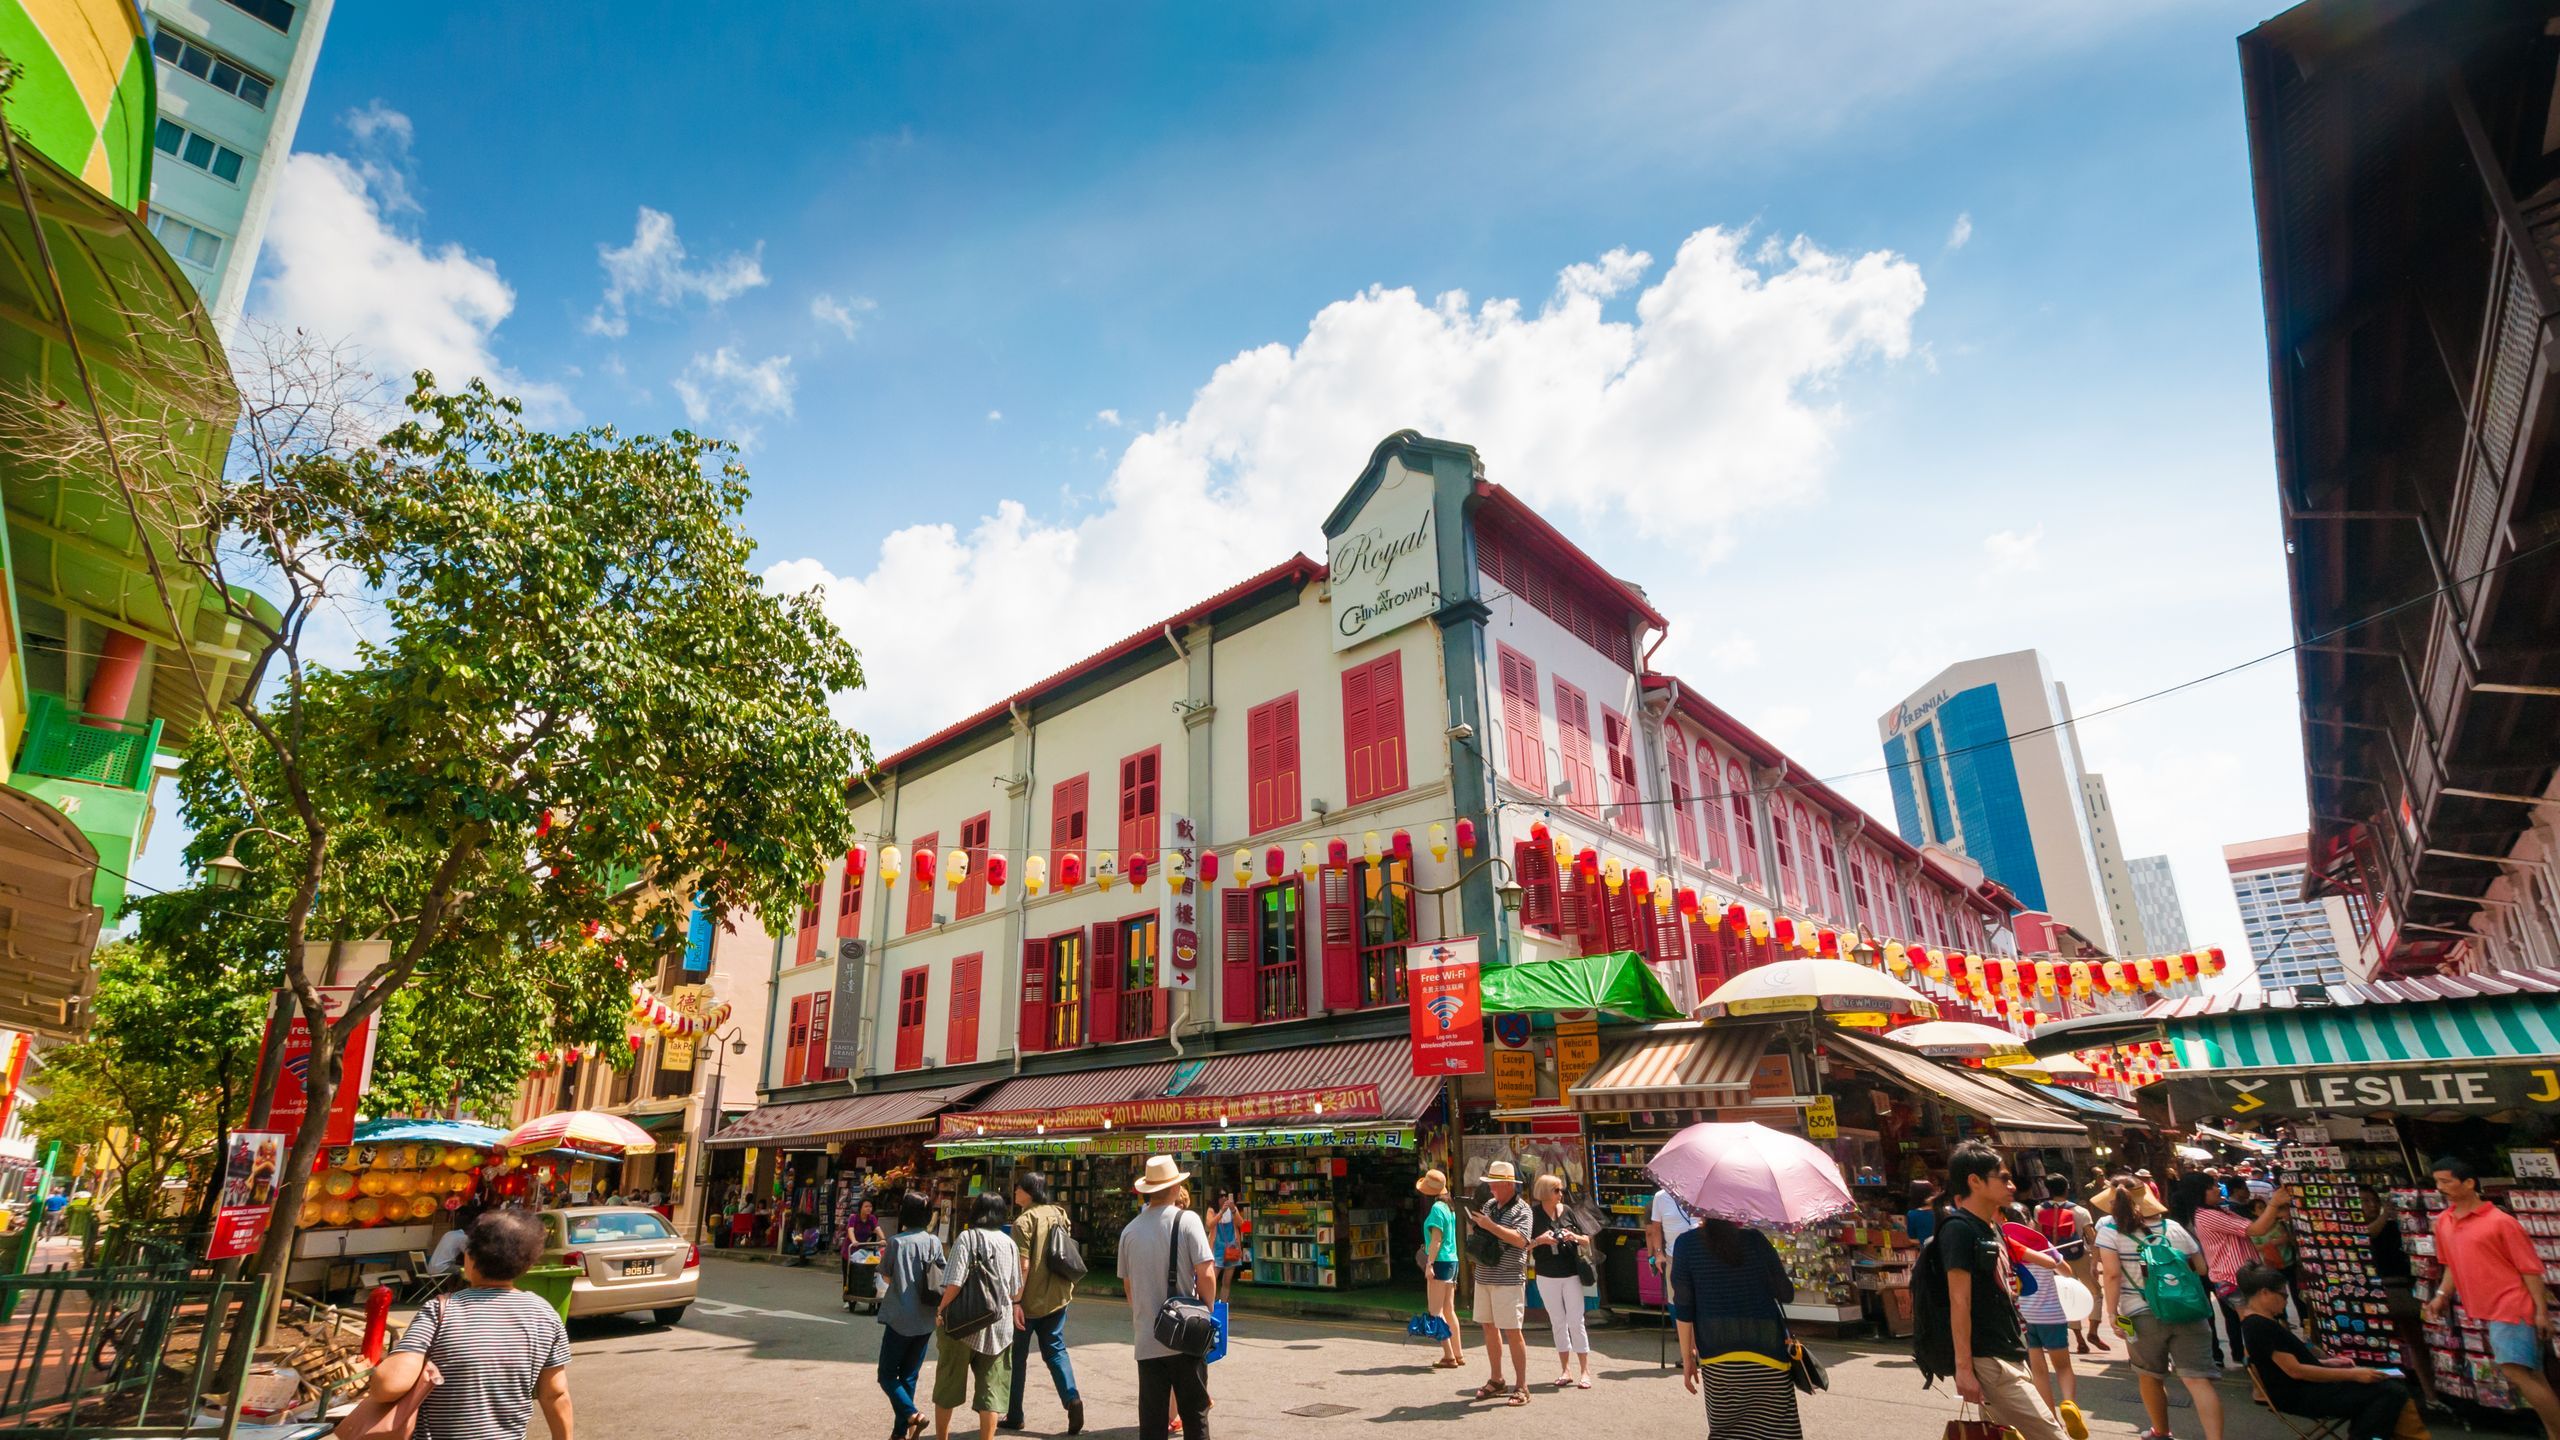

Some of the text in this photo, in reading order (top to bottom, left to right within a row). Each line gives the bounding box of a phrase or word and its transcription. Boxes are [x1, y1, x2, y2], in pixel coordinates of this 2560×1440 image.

[1332, 509, 1430, 586] Royal
[1339, 581, 1430, 637] CHINATOWN
[1889, 689, 1949, 735] PERENNIAL
[1421, 969, 1466, 983] Free Wi-Fi
[677, 992, 698, 1013] 德
[1842, 995, 1893, 1010] NewMoon
[670, 1041, 681, 1050] Tak
[1420, 1040, 1474, 1050] Wireless@Chinatown
[1563, 1038, 1593, 1048] Vehicles
[1502, 1055, 1526, 1065] Except
[1571, 1050, 1585, 1059] Not
[1561, 1062, 1594, 1071] Exceedin
[1496, 1068, 1525, 1080] Loading
[1497, 1081, 1534, 1093] Unloading
[2289, 1072, 2496, 1109] LESLIE
[1141, 1102, 1181, 1122] AWARD
[1118, 1139, 1149, 1152] FREE
[2291, 1150, 2312, 1158] FOR
[2295, 1160, 2315, 1169] FOR
[2518, 1167, 2527, 1177] 3
